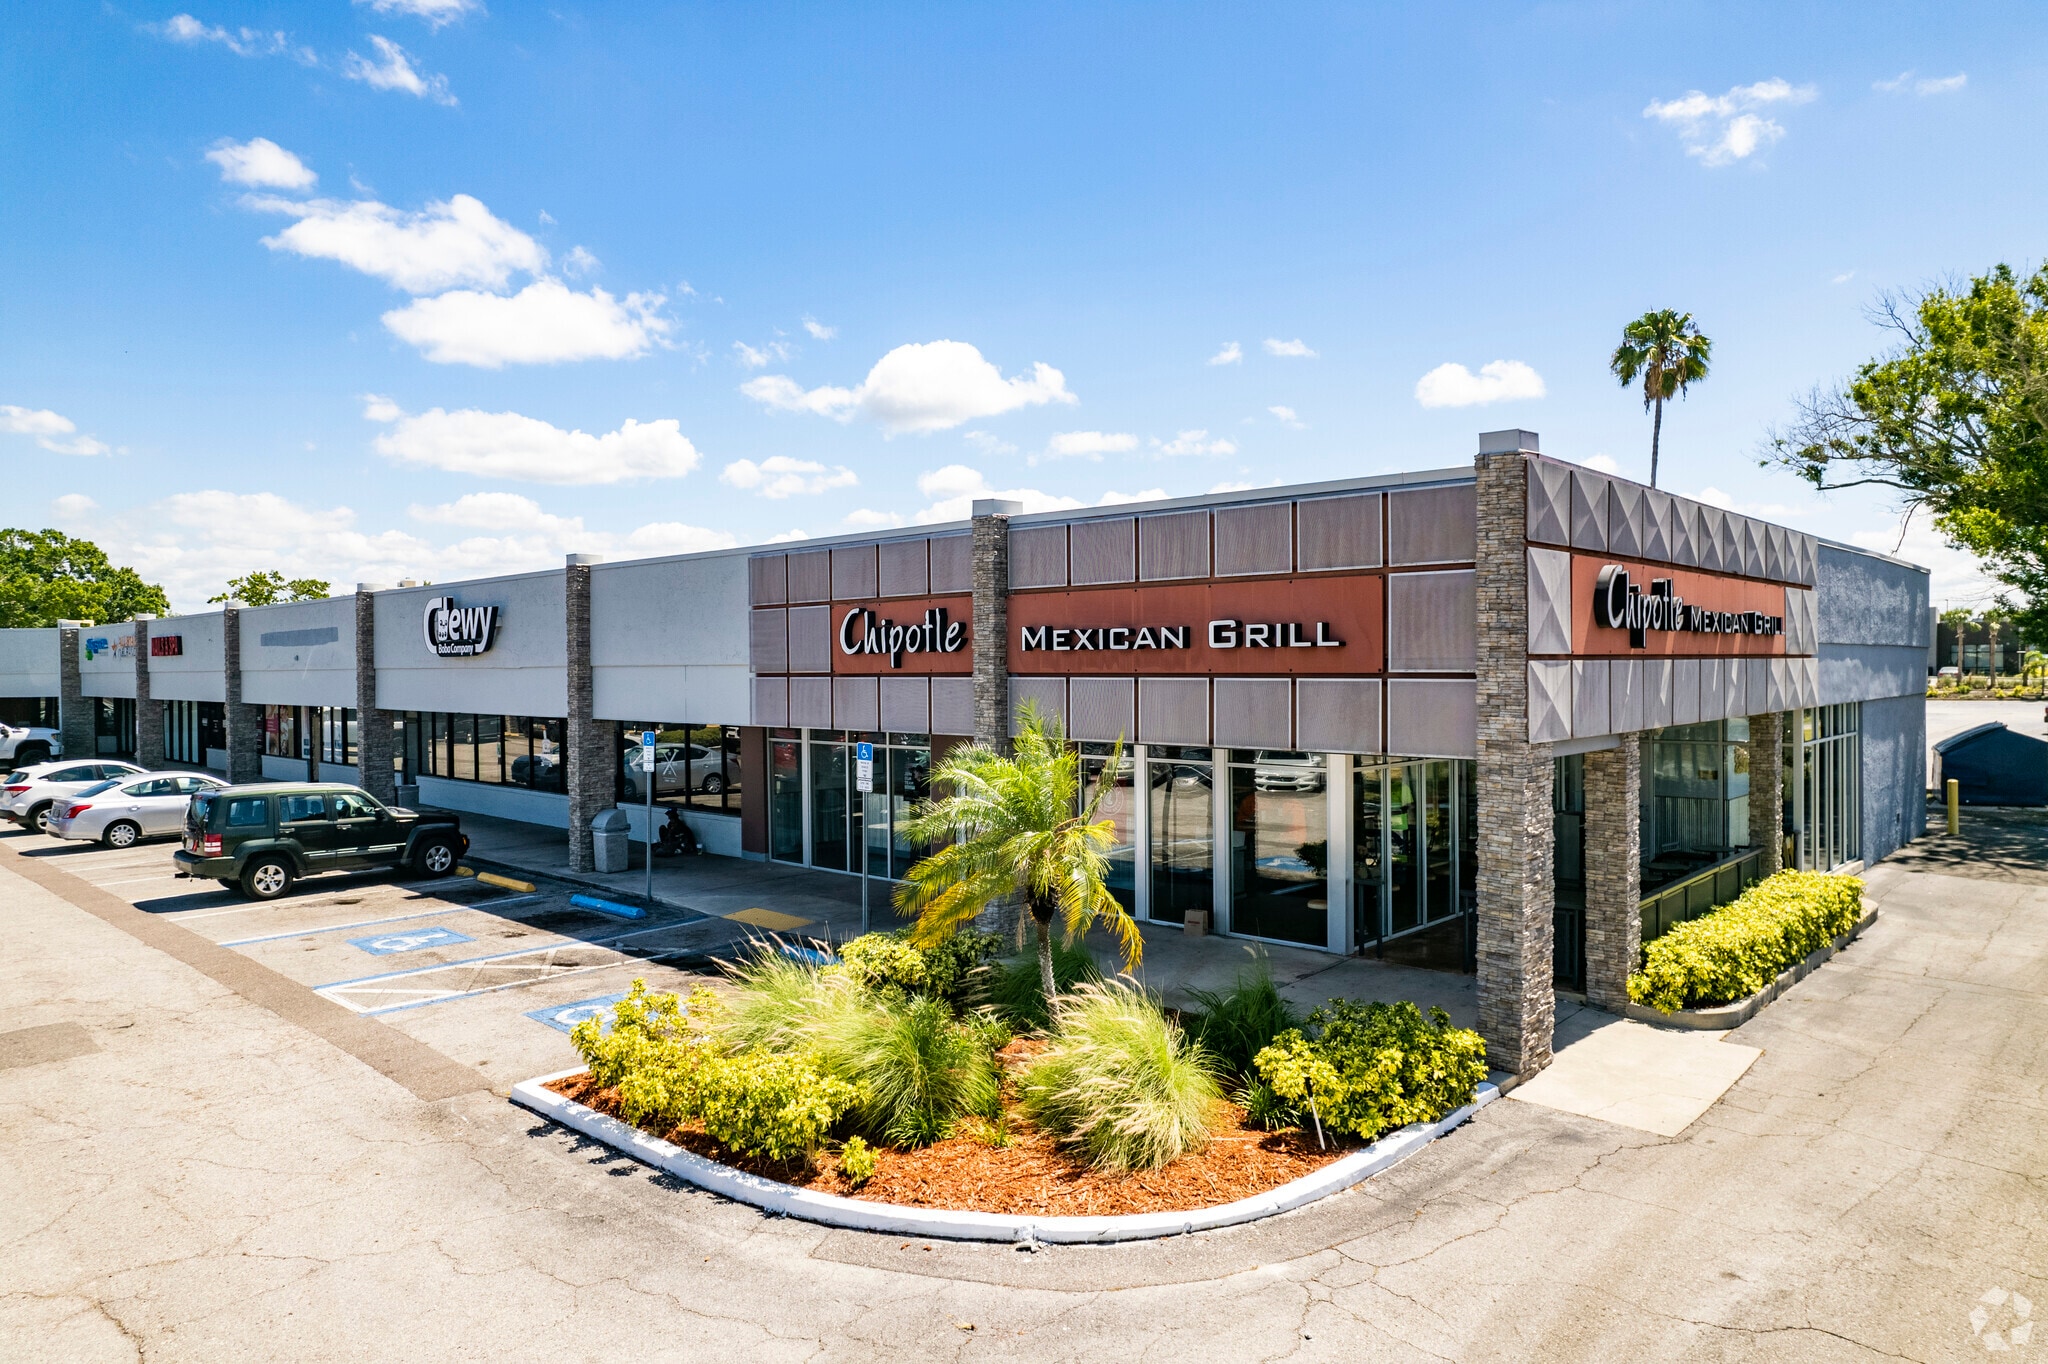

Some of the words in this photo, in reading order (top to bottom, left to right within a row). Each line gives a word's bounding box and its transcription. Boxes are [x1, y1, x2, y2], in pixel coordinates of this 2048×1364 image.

[1598, 564, 1684, 648] Chipotle
[1691, 605, 1749, 633] MEXICAN
[438, 643, 451, 654] Boba
[451, 643, 474, 656] Company
[840, 608, 963, 669] Chipotle
[1021, 626, 1186, 651] MEXICAN
[1208, 619, 1341, 649] GRILL
